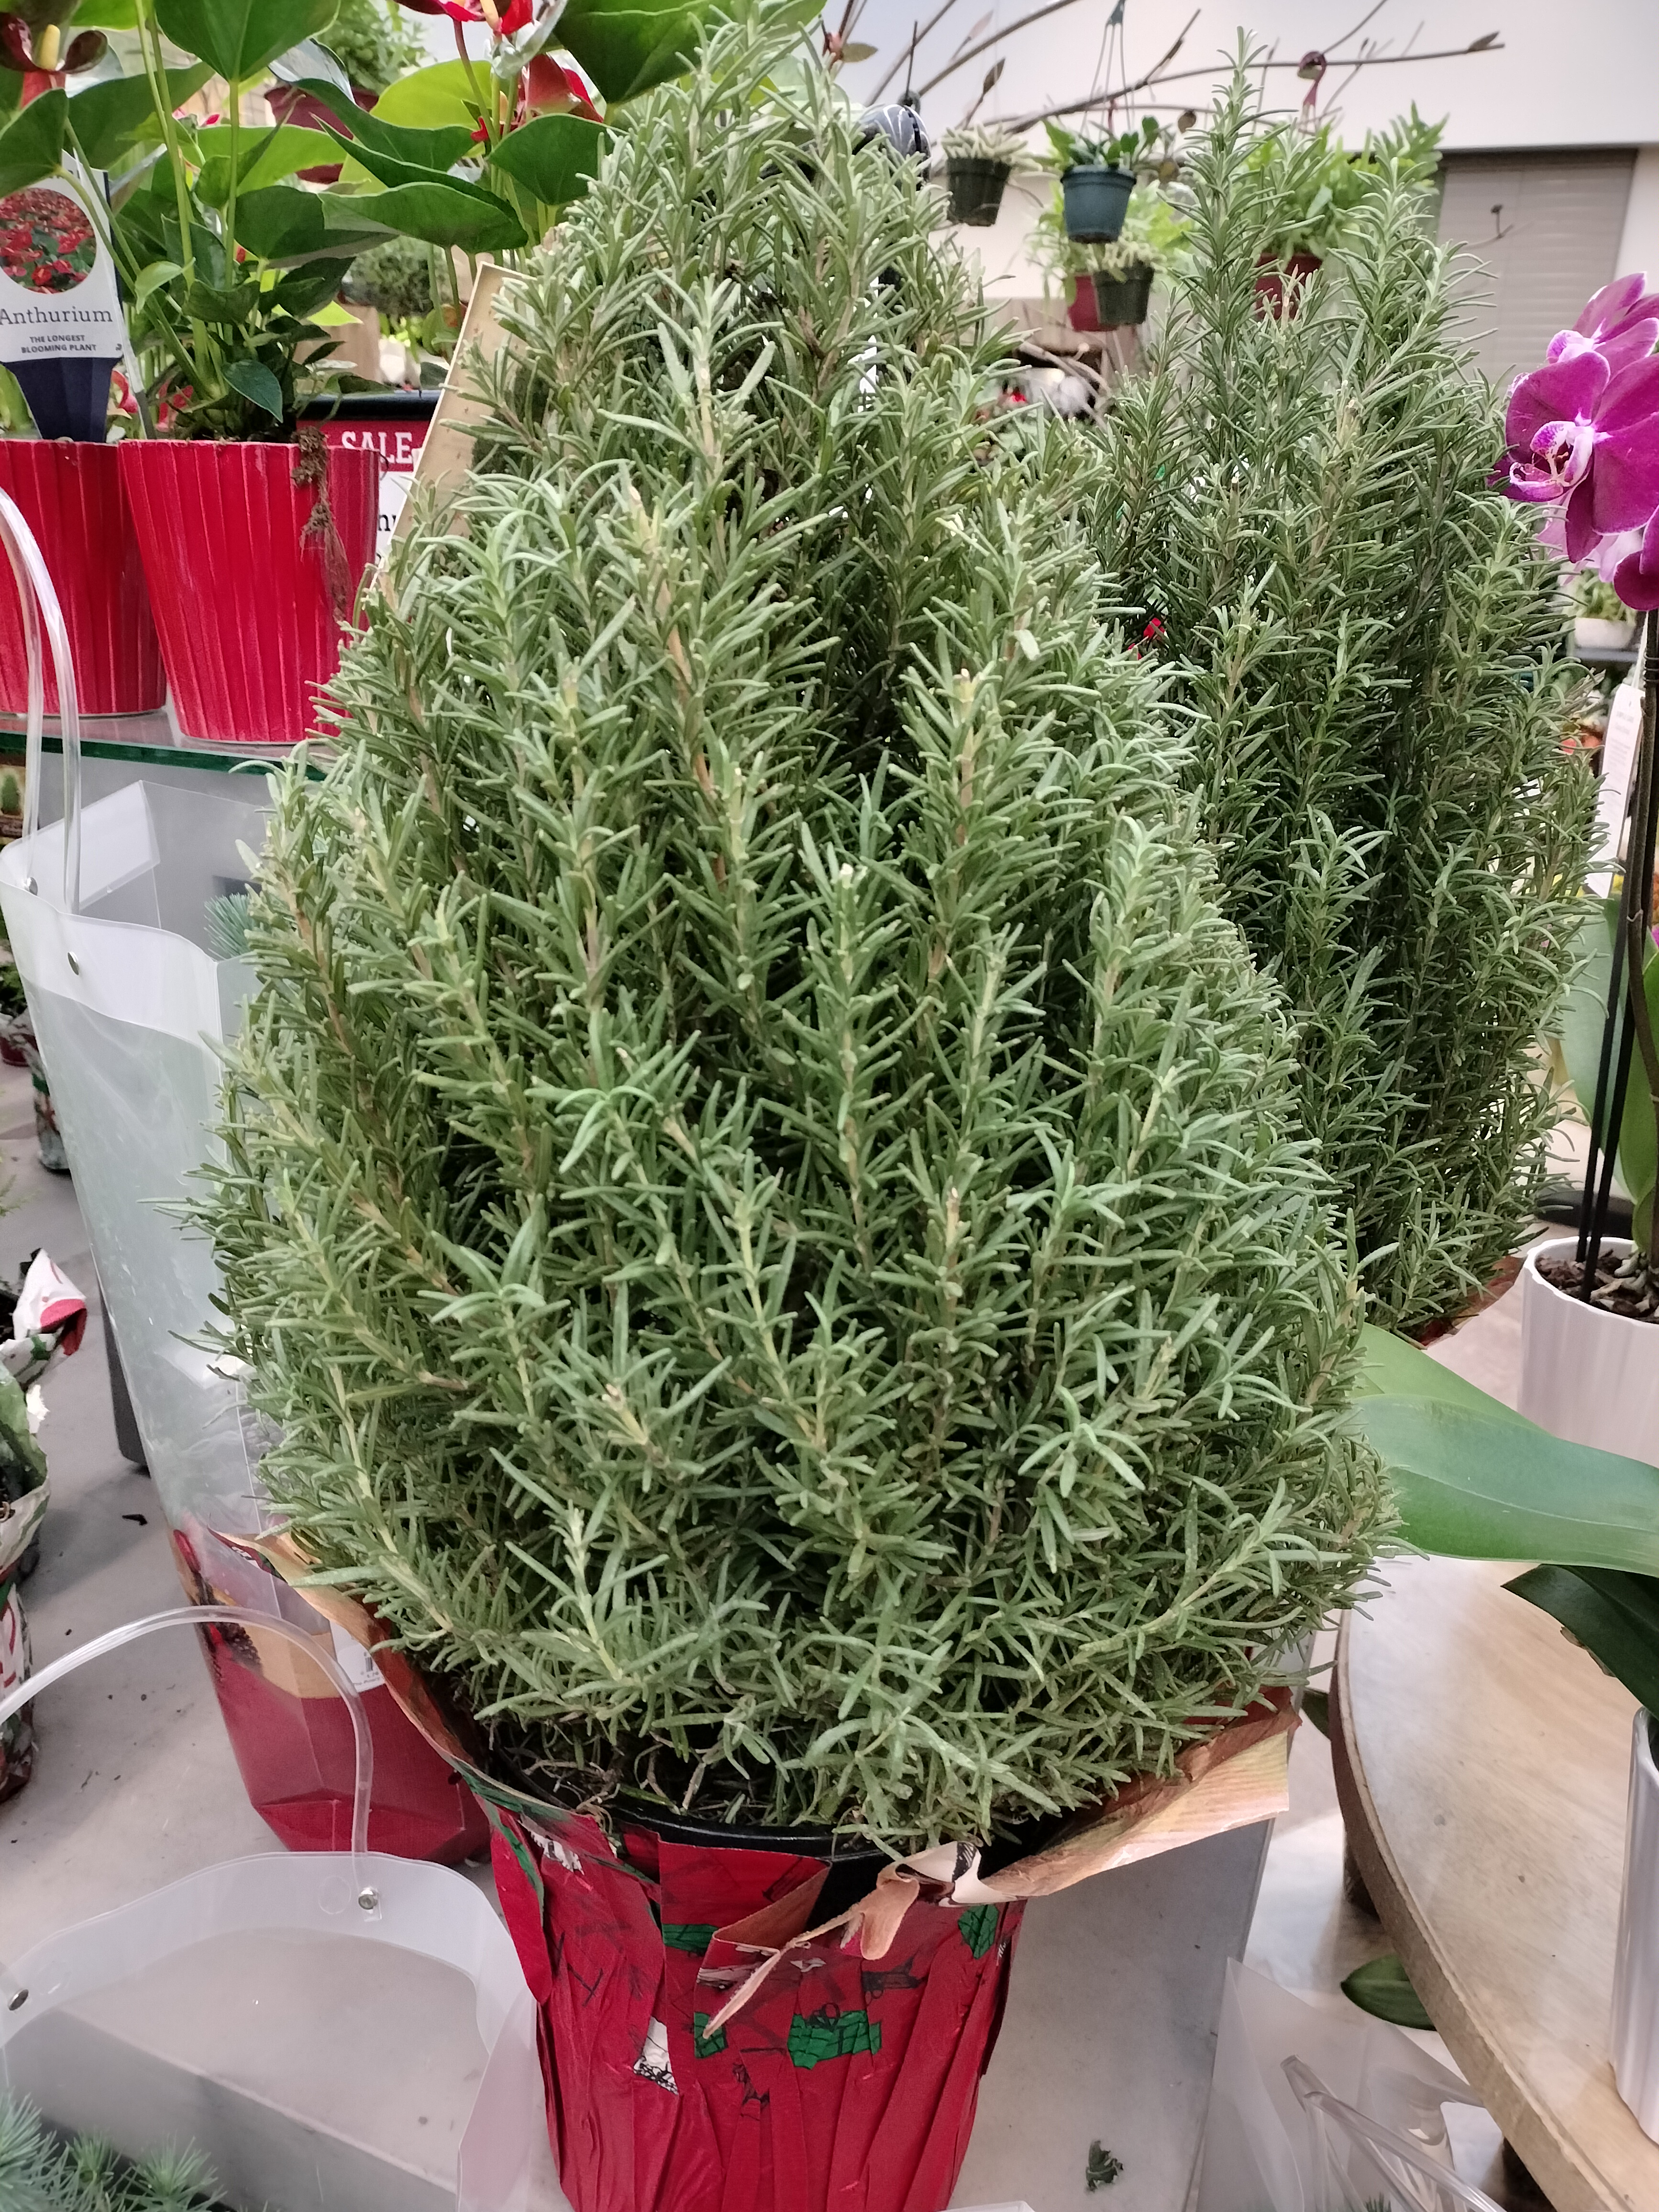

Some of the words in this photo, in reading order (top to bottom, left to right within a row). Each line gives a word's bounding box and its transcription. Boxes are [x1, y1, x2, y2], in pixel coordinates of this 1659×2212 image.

[0, 306, 113, 325] Anthurium
[29, 335, 45, 343] THE
[47, 334, 85, 343] LONGEST
[21, 343, 67, 354] BLOOMING
[342, 431, 413, 464] SALE
